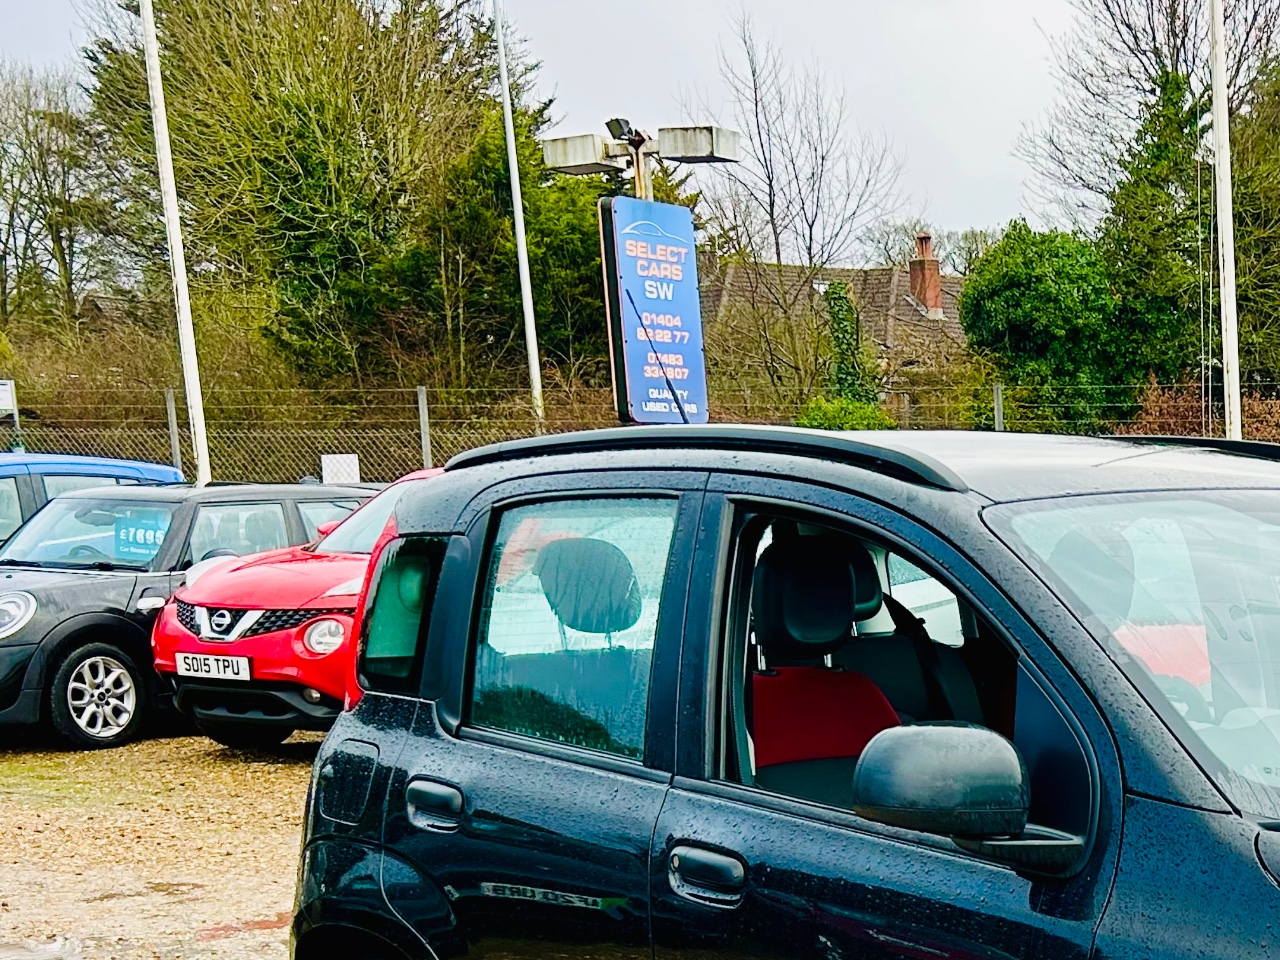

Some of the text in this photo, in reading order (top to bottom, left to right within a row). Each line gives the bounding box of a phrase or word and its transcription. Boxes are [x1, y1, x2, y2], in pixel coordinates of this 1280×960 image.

[625, 239, 689, 263] SELECT
[636, 260, 683, 281] CARS
[644, 280, 674, 300] SW
[642, 311, 682, 328] 01404
[648, 388, 688, 400] QUALTY
[642, 401, 698, 414] USED CRS
[183, 655, 240, 676] SO15 TPU
